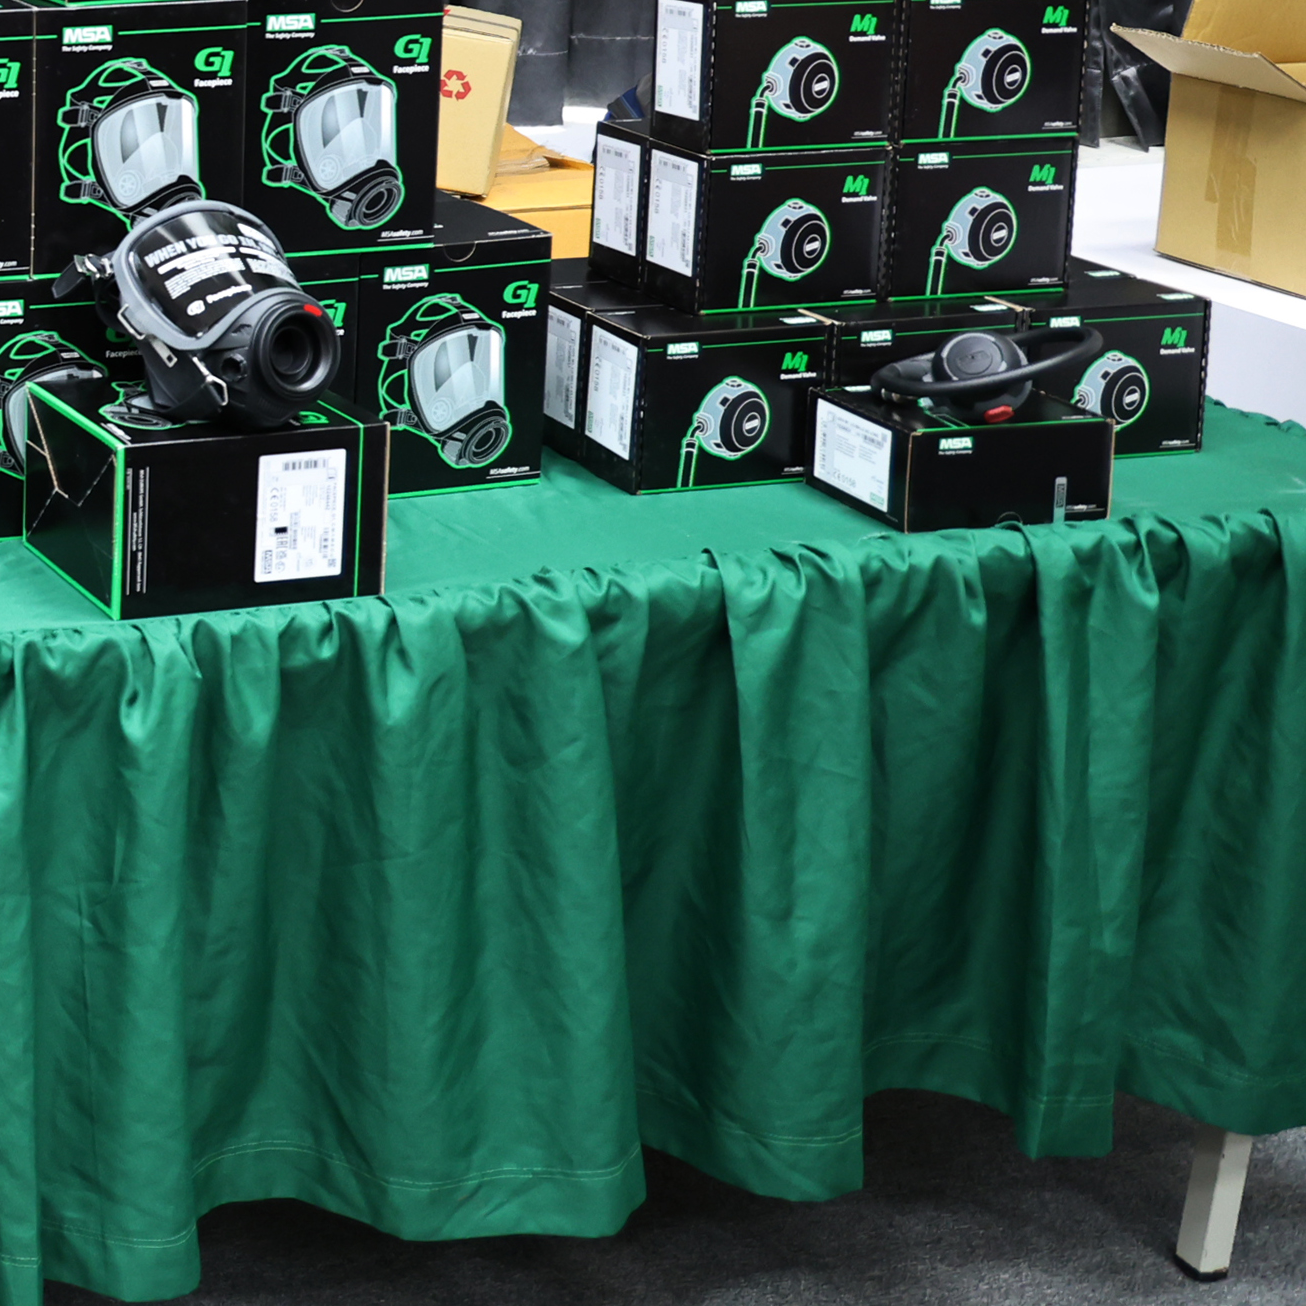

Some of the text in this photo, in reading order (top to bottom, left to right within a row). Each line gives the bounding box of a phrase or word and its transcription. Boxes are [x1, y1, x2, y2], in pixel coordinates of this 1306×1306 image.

[735, 0, 768, 13] MSA
[1042, 5, 1069, 26] M1
[266, 13, 316, 32] MSA
[850, 14, 878, 35] M1
[62, 25, 113, 45] MSA
[393, 34, 432, 63] G1
[194, 47, 235, 77] G1
[393, 65, 430, 74] Facepiece
[194, 76, 233, 88] Facepiece
[917, 152, 949, 164] MSA
[730, 163, 763, 176] MSA
[1029, 164, 1056, 184] M1
[843, 175, 870, 195] M1
[144, 237, 188, 268] WHEN
[384, 264, 429, 283] MSA
[503, 280, 539, 308] G1
[502, 309, 537, 319] Facepiece
[1050, 316, 1081, 328] MSA
[861, 329, 893, 343] MSA
[1161, 327, 1187, 347] M1
[667, 342, 699, 355] MSA
[781, 351, 808, 372] M1
[939, 437, 973, 450] MSA
